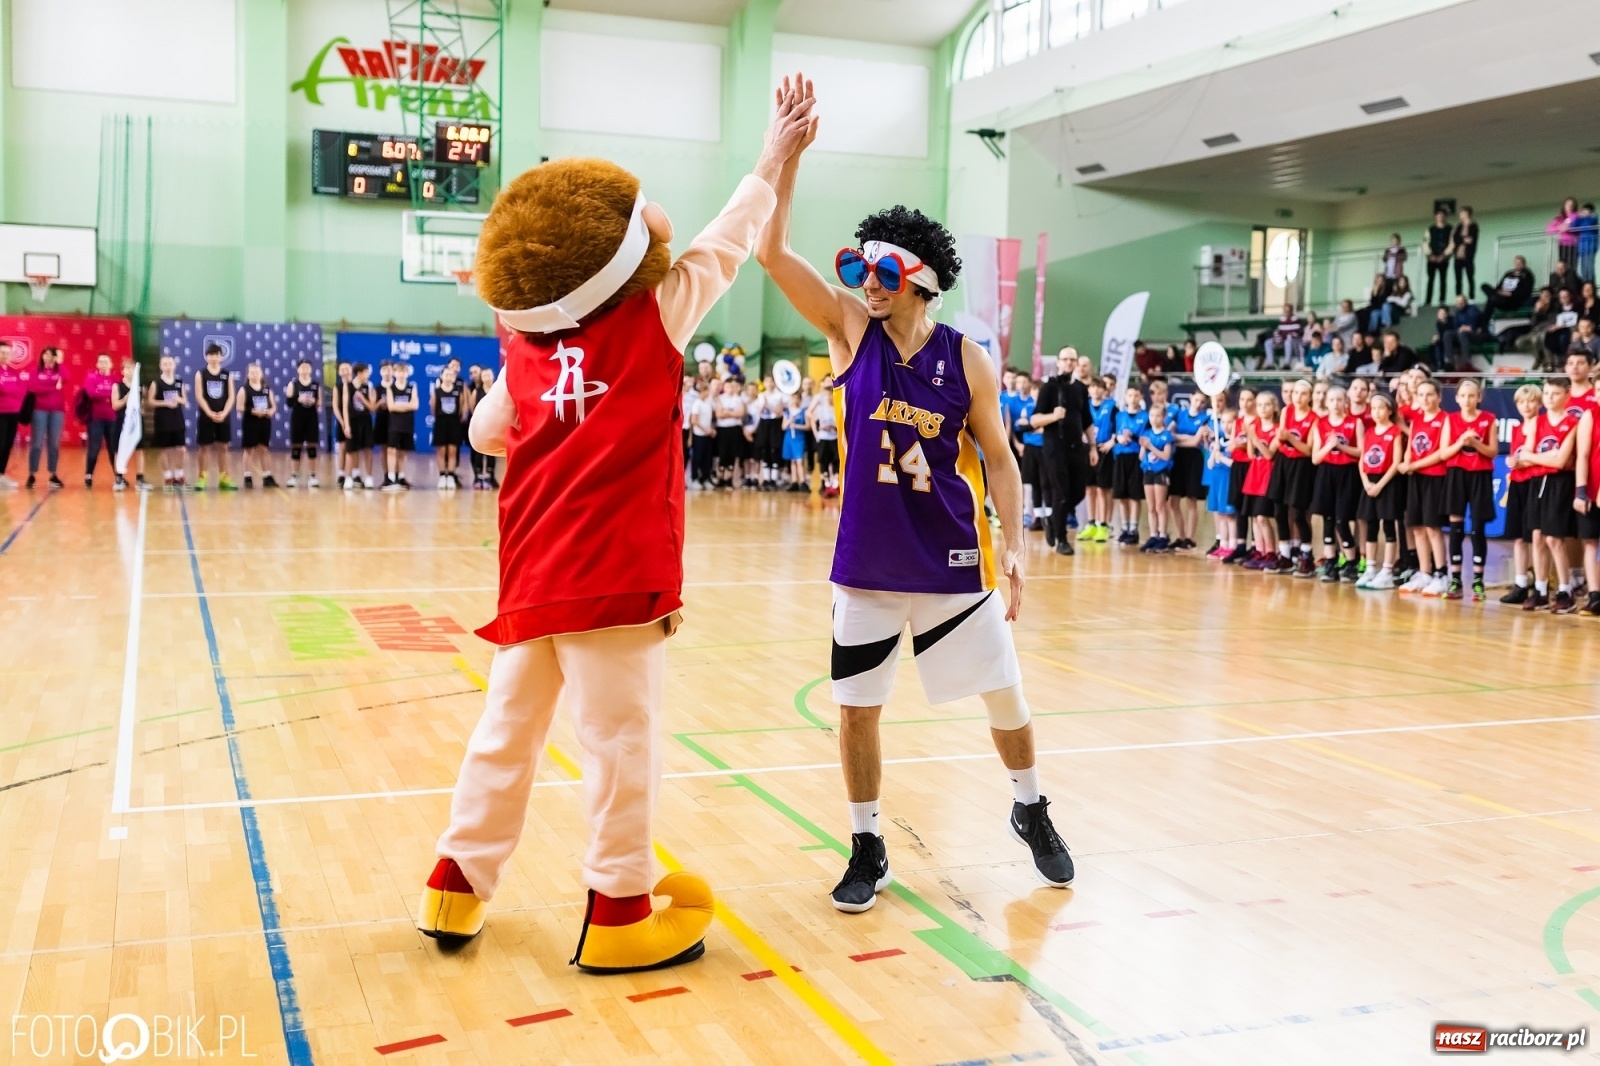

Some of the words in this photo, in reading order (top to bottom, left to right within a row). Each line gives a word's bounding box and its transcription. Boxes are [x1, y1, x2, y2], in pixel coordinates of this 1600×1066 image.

[354, 176, 366, 194] 0
[423, 181, 435, 198] 0
[869, 397, 945, 439] AKERS
